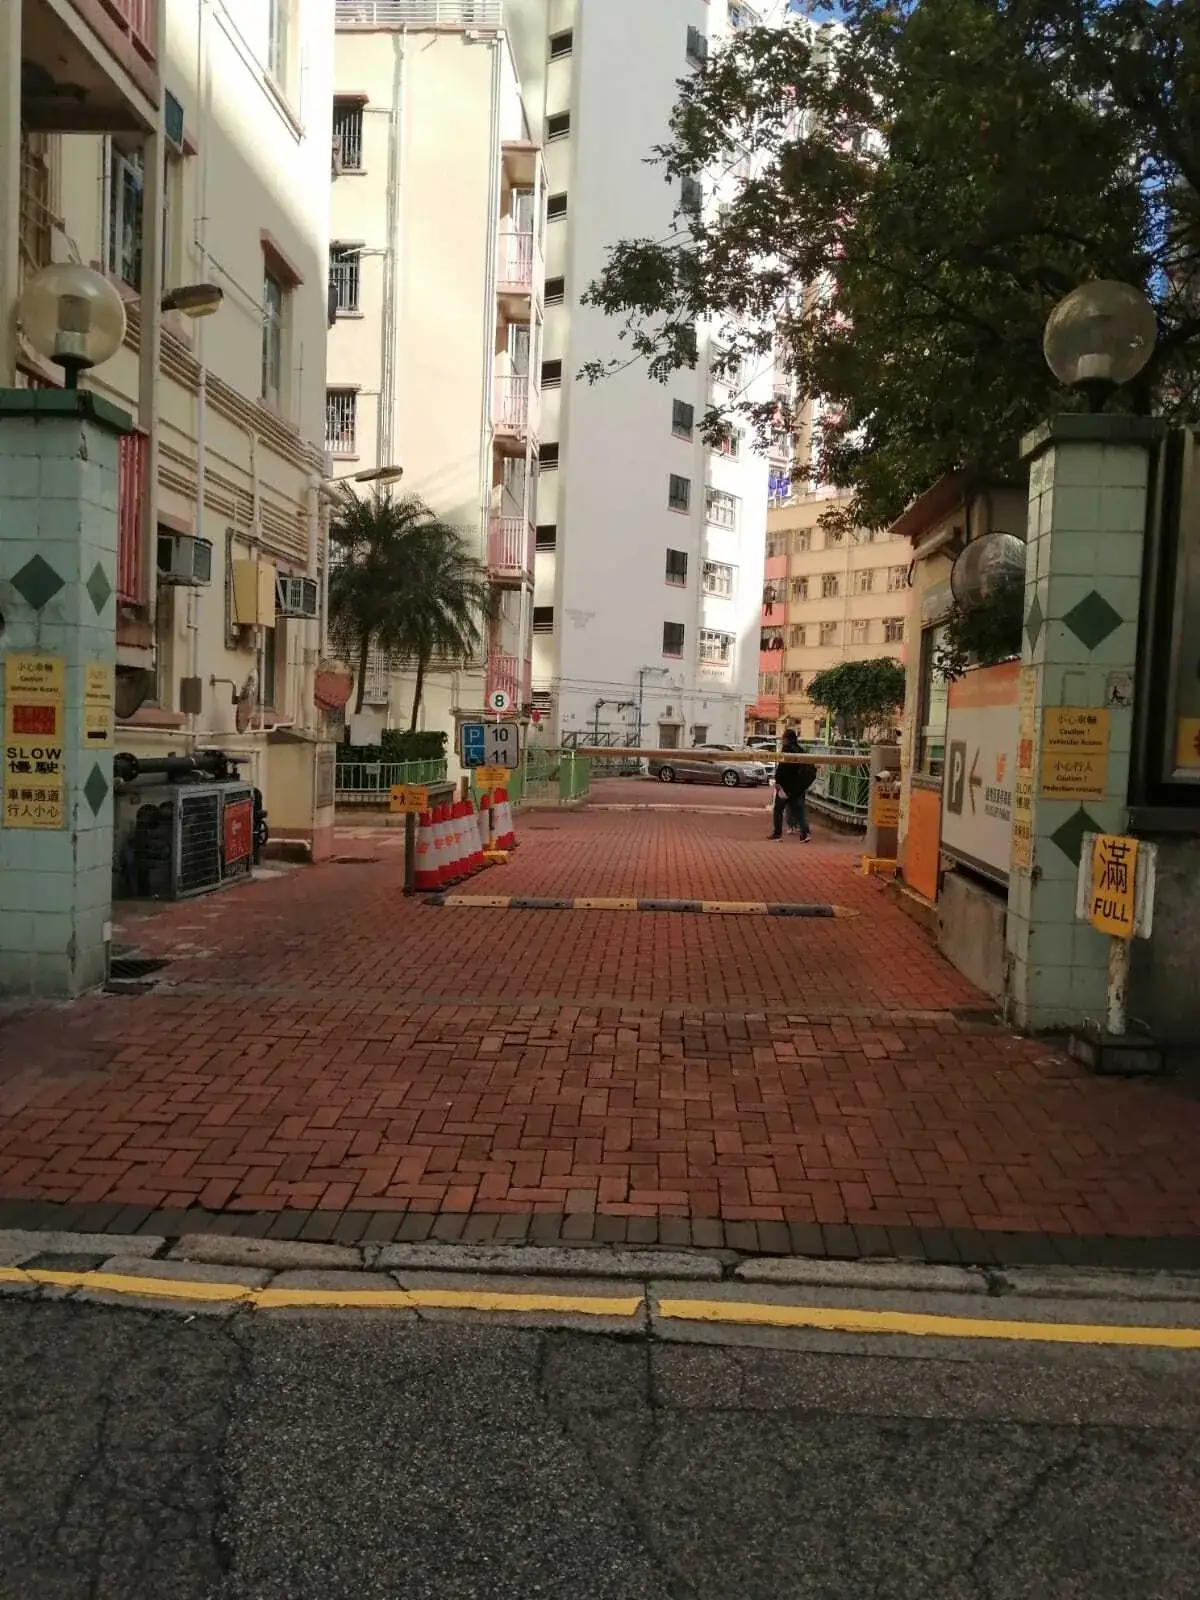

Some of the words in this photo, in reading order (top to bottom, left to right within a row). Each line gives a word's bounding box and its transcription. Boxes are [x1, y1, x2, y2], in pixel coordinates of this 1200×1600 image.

[495, 694, 504, 708] 8
[469, 728, 480, 743] P
[491, 728, 509, 742] 10
[7, 747, 62, 760] SLOW
[491, 750, 508, 764] 11
[8, 761, 60, 775] 慢駛
[7, 803, 60, 818] 行人小心
[1099, 839, 1131, 894] 滿
[1093, 896, 1129, 923] FULL
